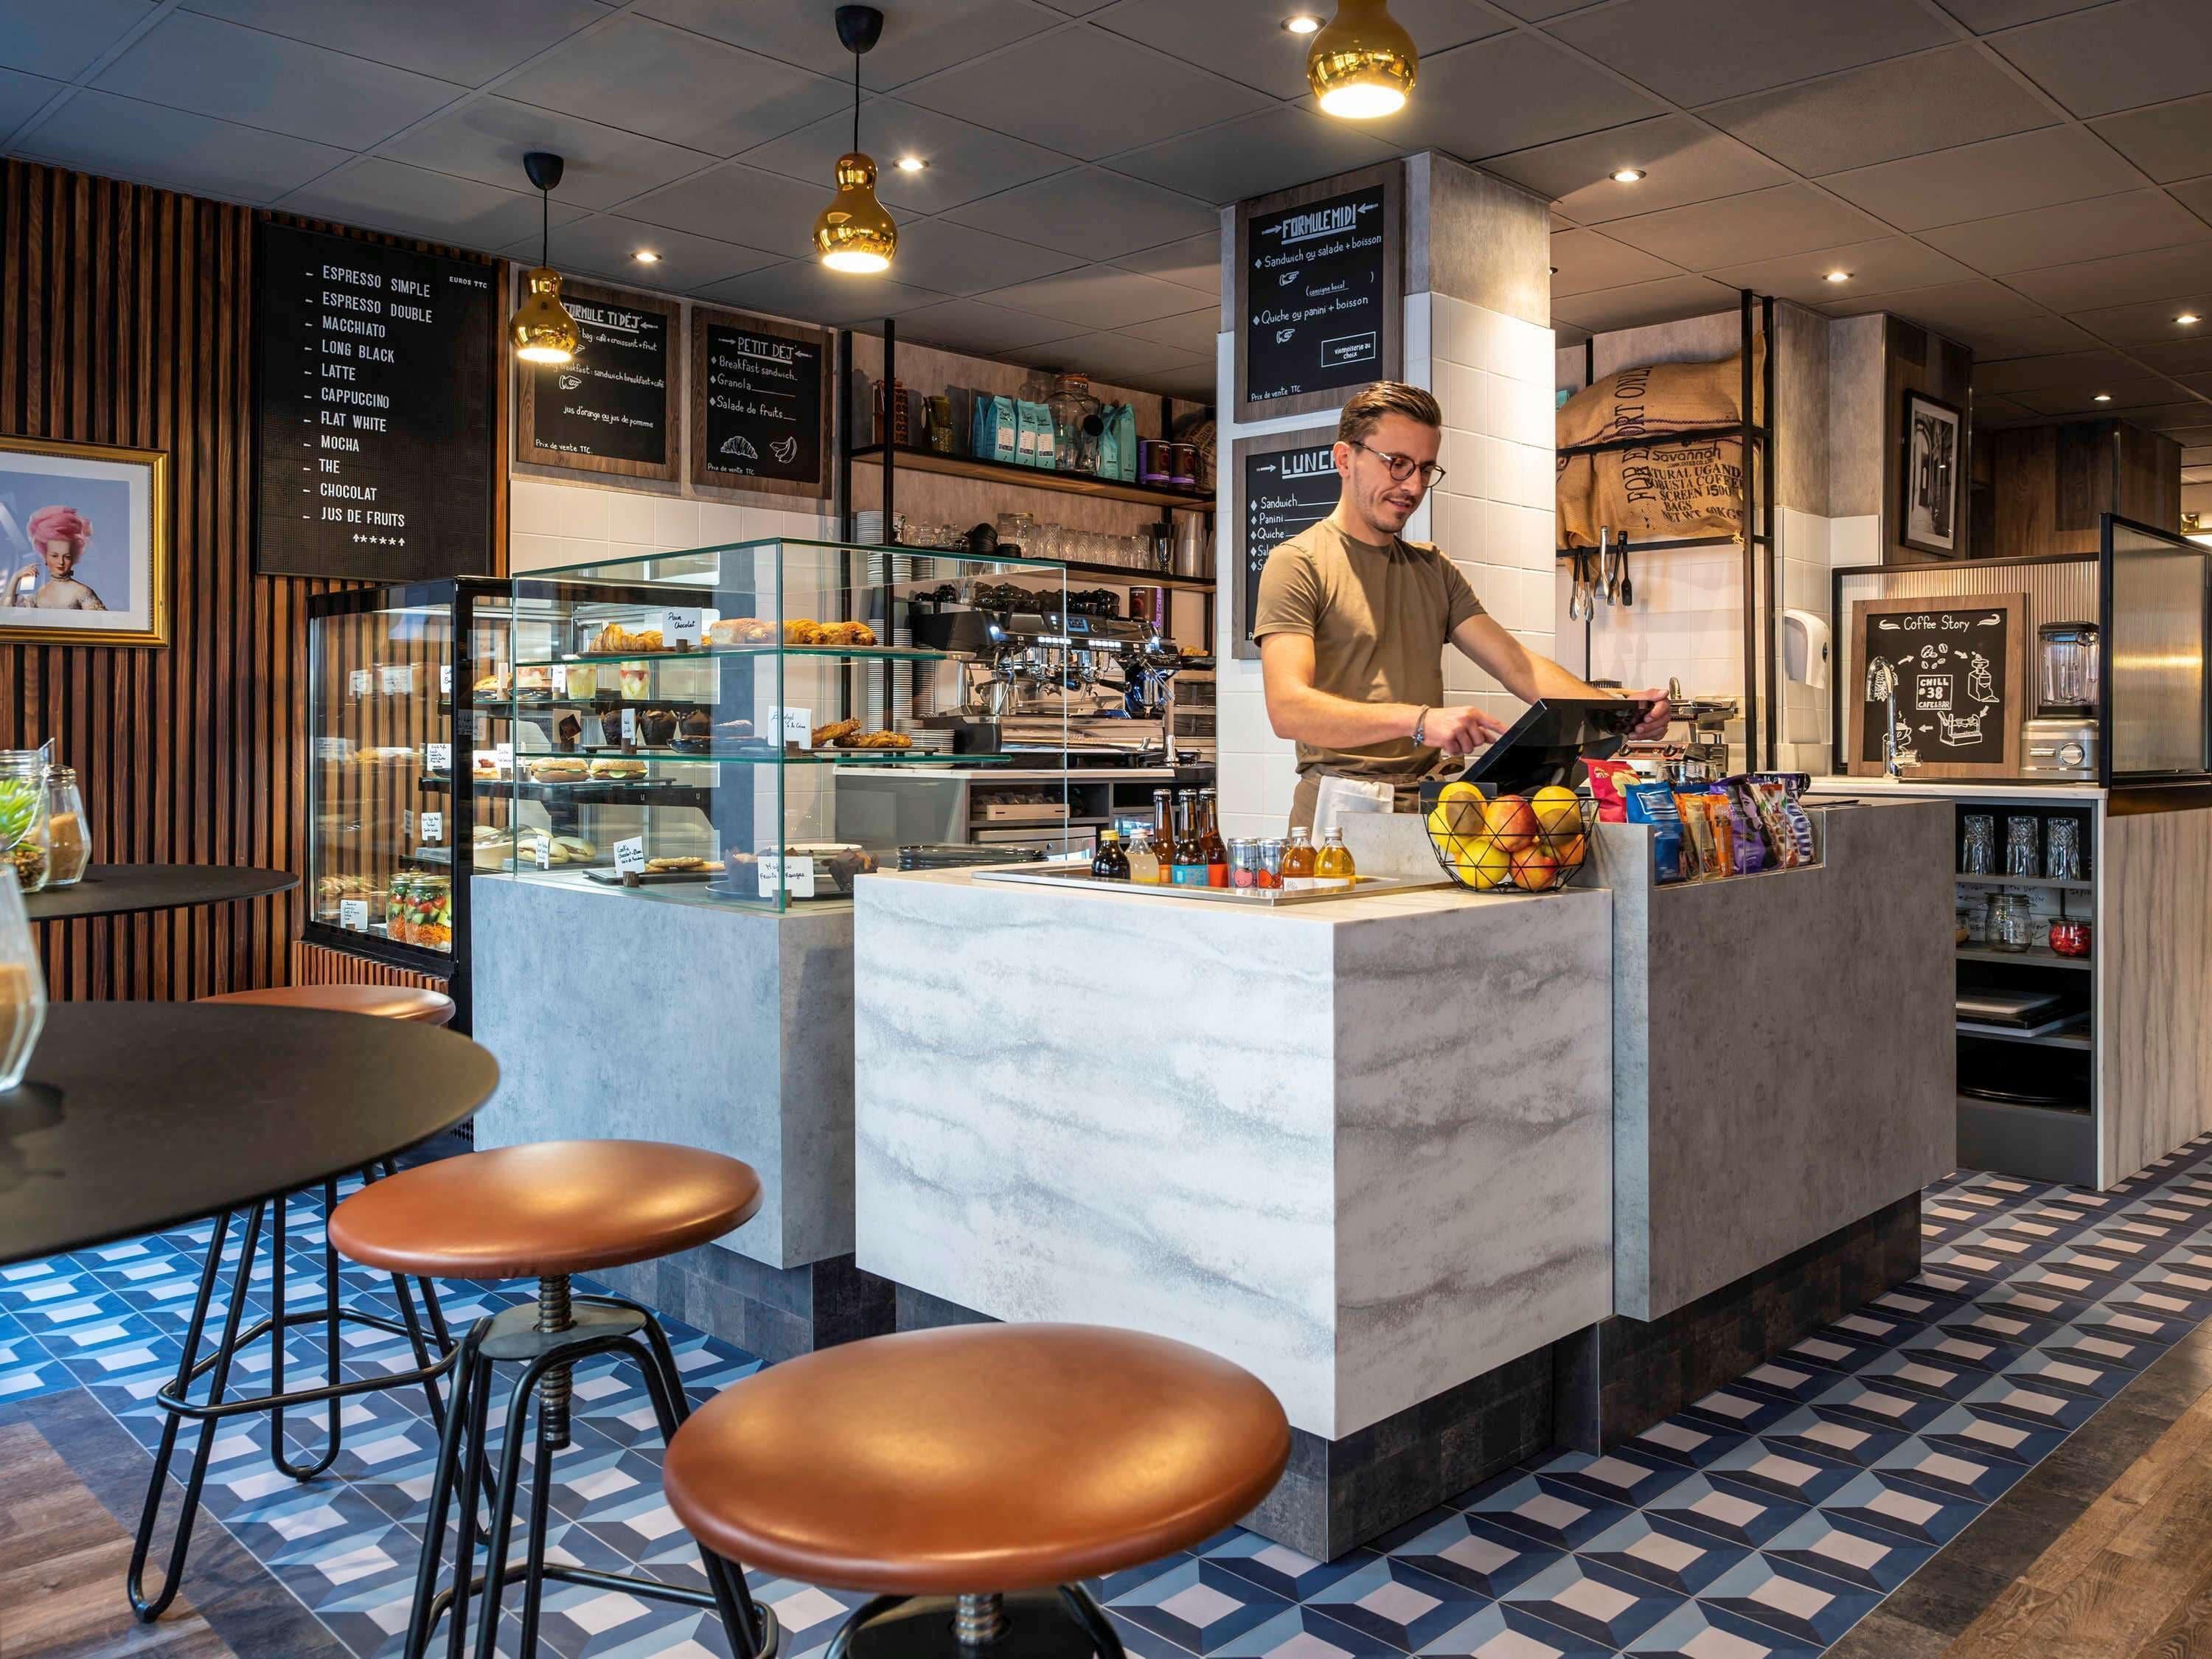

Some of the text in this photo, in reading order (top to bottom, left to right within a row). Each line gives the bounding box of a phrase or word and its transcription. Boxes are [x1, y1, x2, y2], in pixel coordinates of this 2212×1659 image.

[1282, 204, 1356, 239] FORMULE MIDI
[1265, 248, 1304, 267] Sandwich
[1306, 251, 1315, 260] ou
[1318, 243, 1343, 257] salade
[1352, 235, 1382, 248] boisson
[323, 265, 431, 298] ESPRESSO SIMPLE
[449, 276, 488, 288] EUROS TTC
[322, 292, 432, 323] ESPRESSO DOUBLE
[1262, 310, 1289, 324] Quiche
[1292, 311, 1301, 321] ou
[1304, 306, 1326, 321] panini
[1336, 296, 1368, 310] boisson
[322, 316, 385, 338] MACCHIATO
[321, 340, 394, 364] LONG BLACK
[738, 337, 768, 355] PETIT
[321, 364, 355, 381] LATTE
[594, 369, 623, 380] sandwich
[719, 355, 794, 380] Breakfast sandwich
[717, 372, 751, 390] Granola
[1614, 366, 1653, 398] ONL
[321, 388, 389, 408] CAPPUCCINO
[1251, 393, 1262, 402] Prix
[1271, 386, 1288, 397] vente
[1291, 385, 1301, 393] TTC
[563, 406, 575, 414] jus
[609, 414, 619, 424] jus
[622, 415, 629, 423] de
[717, 394, 782, 418] Salade de fruits
[321, 411, 387, 432] FLAT WHITE
[321, 436, 359, 452] MOCHA
[535, 439, 549, 448] Prix
[559, 443, 577, 451] vente
[580, 445, 591, 453] TTC
[1652, 442, 1721, 462] Savannah
[319, 459, 340, 474] THE
[708, 462, 719, 470] Prix
[1694, 463, 1743, 478] UGAND
[320, 483, 377, 501] CHOCOLAT
[1622, 466, 1656, 503] FOR
[1261, 493, 1298, 509] Sandwich
[1659, 487, 1703, 502] SCREEN
[1663, 501, 1692, 512] BAGS
[321, 507, 405, 527] JUS DE FRUITS
[1259, 512, 1283, 524] Panini
[1257, 527, 1284, 540] Quiche
[1904, 615, 1970, 633] Coffee Story
[1920, 678, 1949, 686] CHILL
